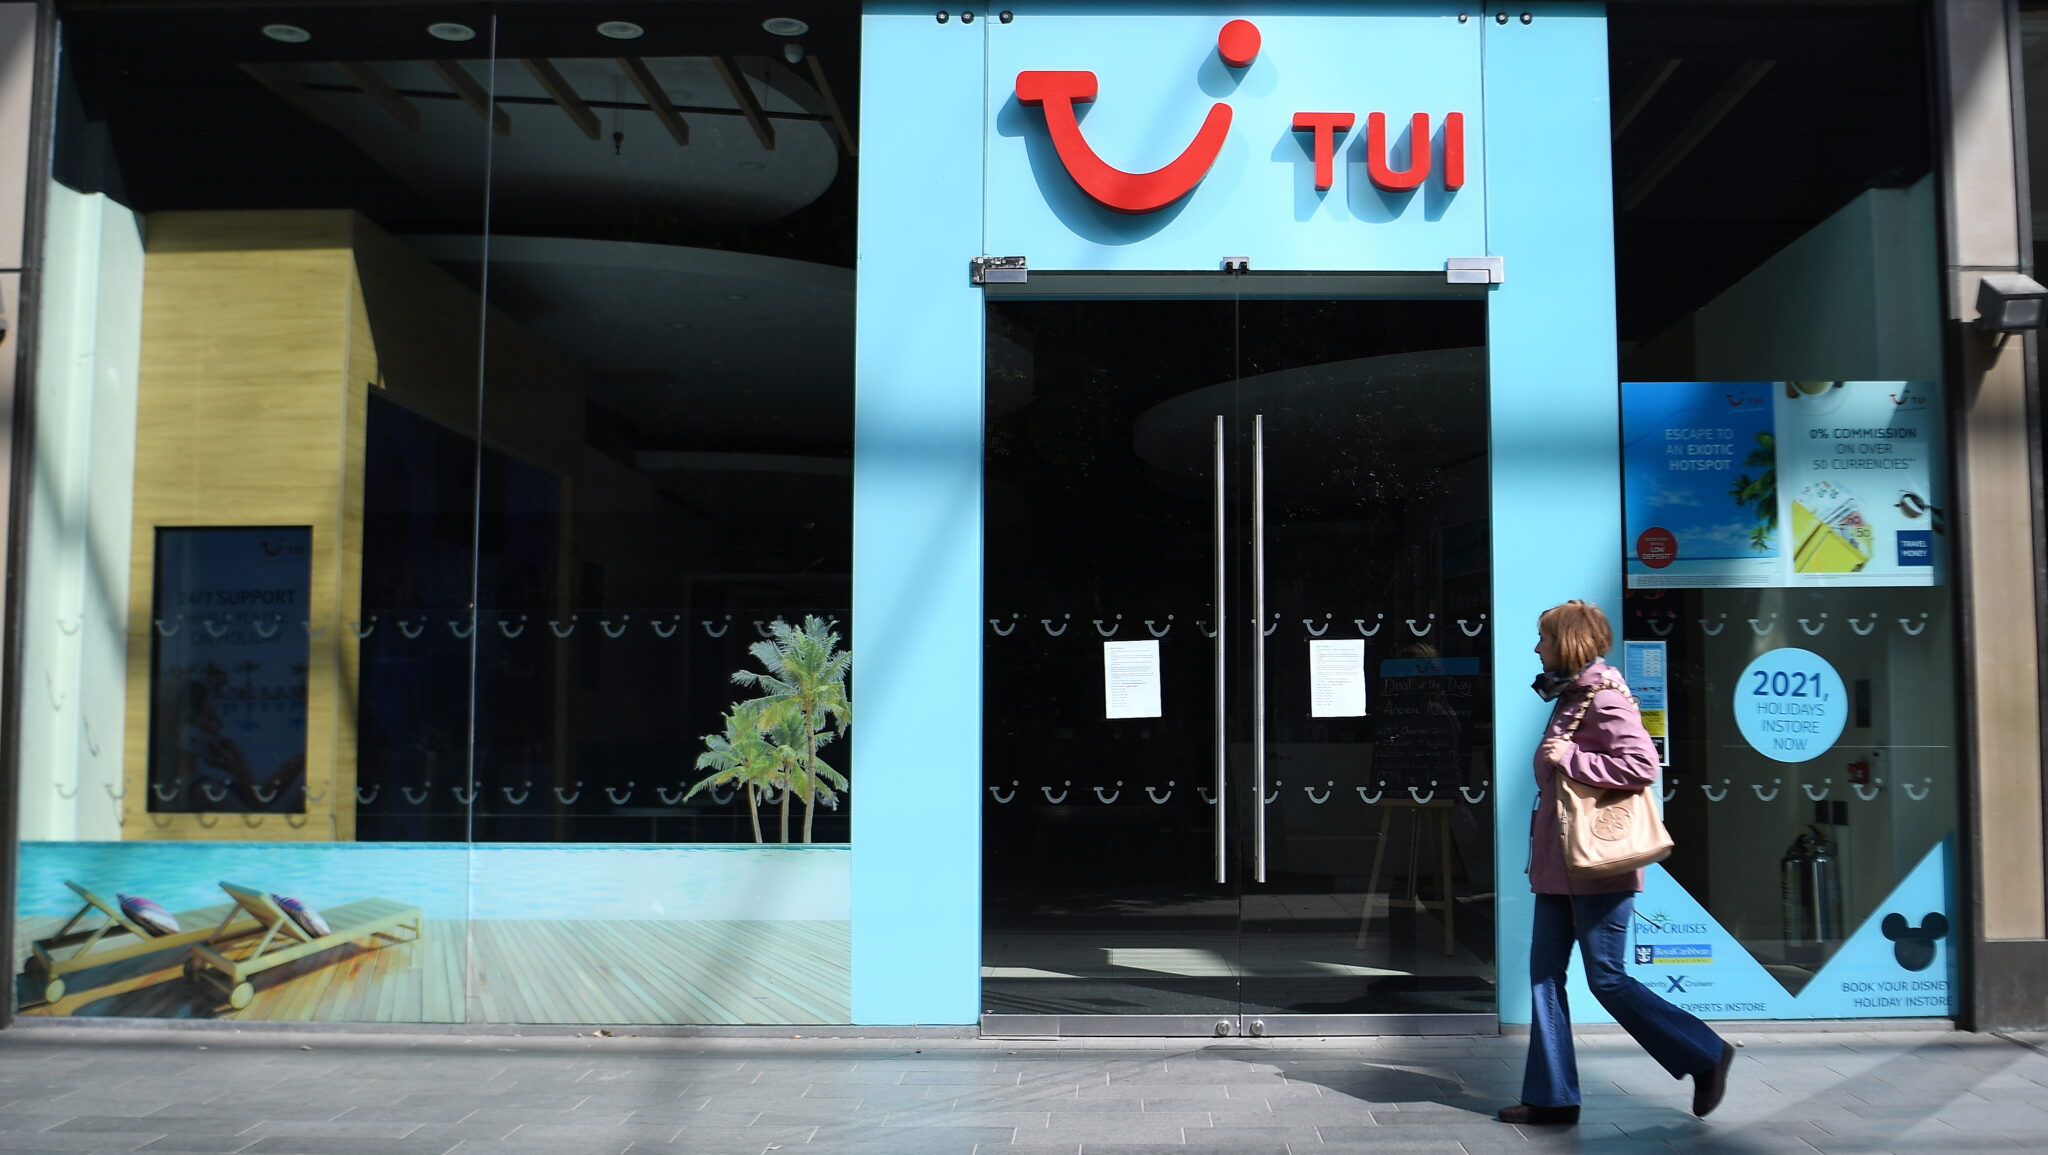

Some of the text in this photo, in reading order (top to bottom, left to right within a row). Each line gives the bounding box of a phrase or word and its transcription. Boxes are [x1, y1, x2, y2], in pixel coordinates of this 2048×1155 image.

[1292, 112, 1464, 192] TUI
[1665, 428, 1734, 441] ESCAPE TO
[1810, 428, 1917, 440] 0% COMMISSION
[1666, 444, 1734, 456] AN EXOTIC
[1836, 443, 1893, 454] ON OVER
[1669, 459, 1732, 471] HOTSPOT
[1813, 459, 1828, 470] 50
[1900, 540, 1928, 548] TRAVEL
[216, 589, 296, 605] SUPPORT
[1753, 671, 1829, 702] 2021,
[1757, 702, 1825, 716] HOLIDAYS
[1762, 720, 1820, 733] INSTORE
[1774, 737, 1808, 751] NOW
[1636, 923, 1659, 934] P&O
[1842, 980, 1952, 992] BOOK YOUR DISNEY
[1680, 1002, 1766, 1012] EXPERTS INSTORE
[1854, 996, 1953, 1008] HOLIDAY INSTORE
